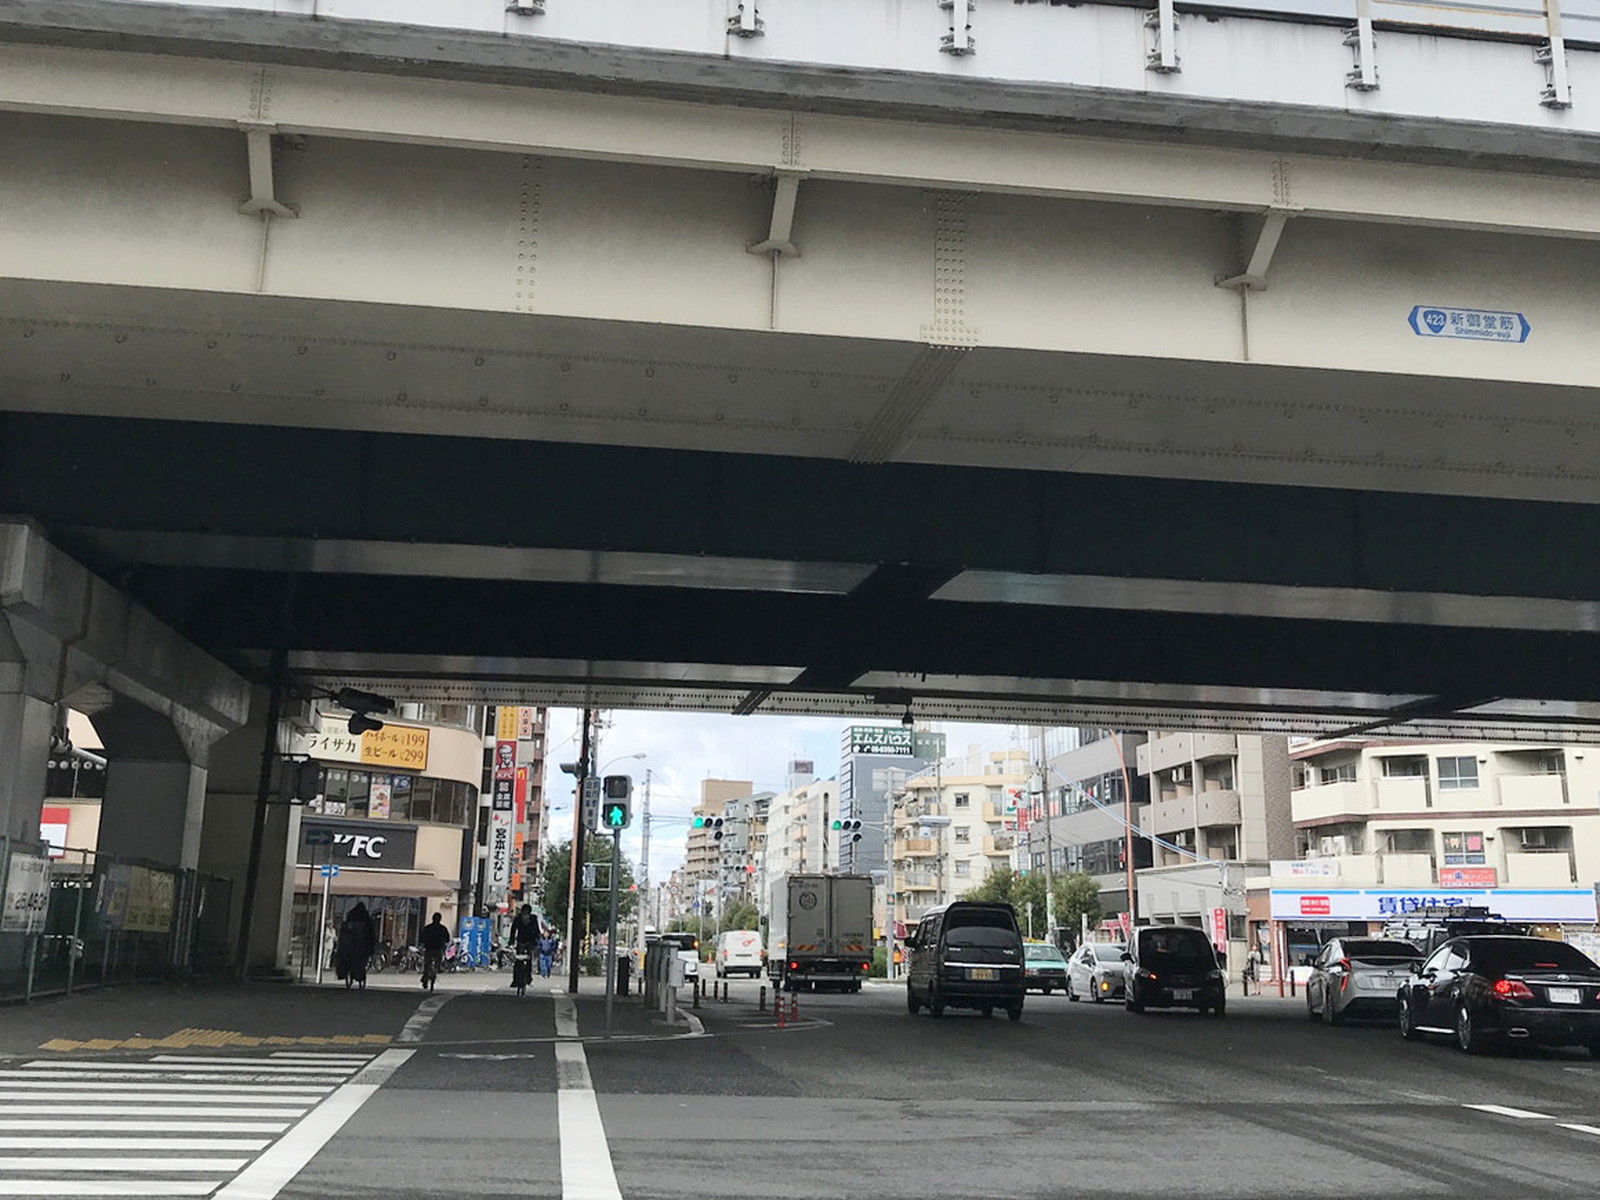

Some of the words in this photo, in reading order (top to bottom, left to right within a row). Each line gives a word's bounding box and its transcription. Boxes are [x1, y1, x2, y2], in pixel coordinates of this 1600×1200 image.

[1426, 313, 1445, 326] 423
[1450, 312, 1514, 330] 新御堂筋
[406, 733, 425, 746] 199
[364, 746, 397, 758] 生ビール
[404, 748, 424, 762] 299
[496, 771, 513, 779] KFC
[493, 828, 508, 882] 宮本むなし
